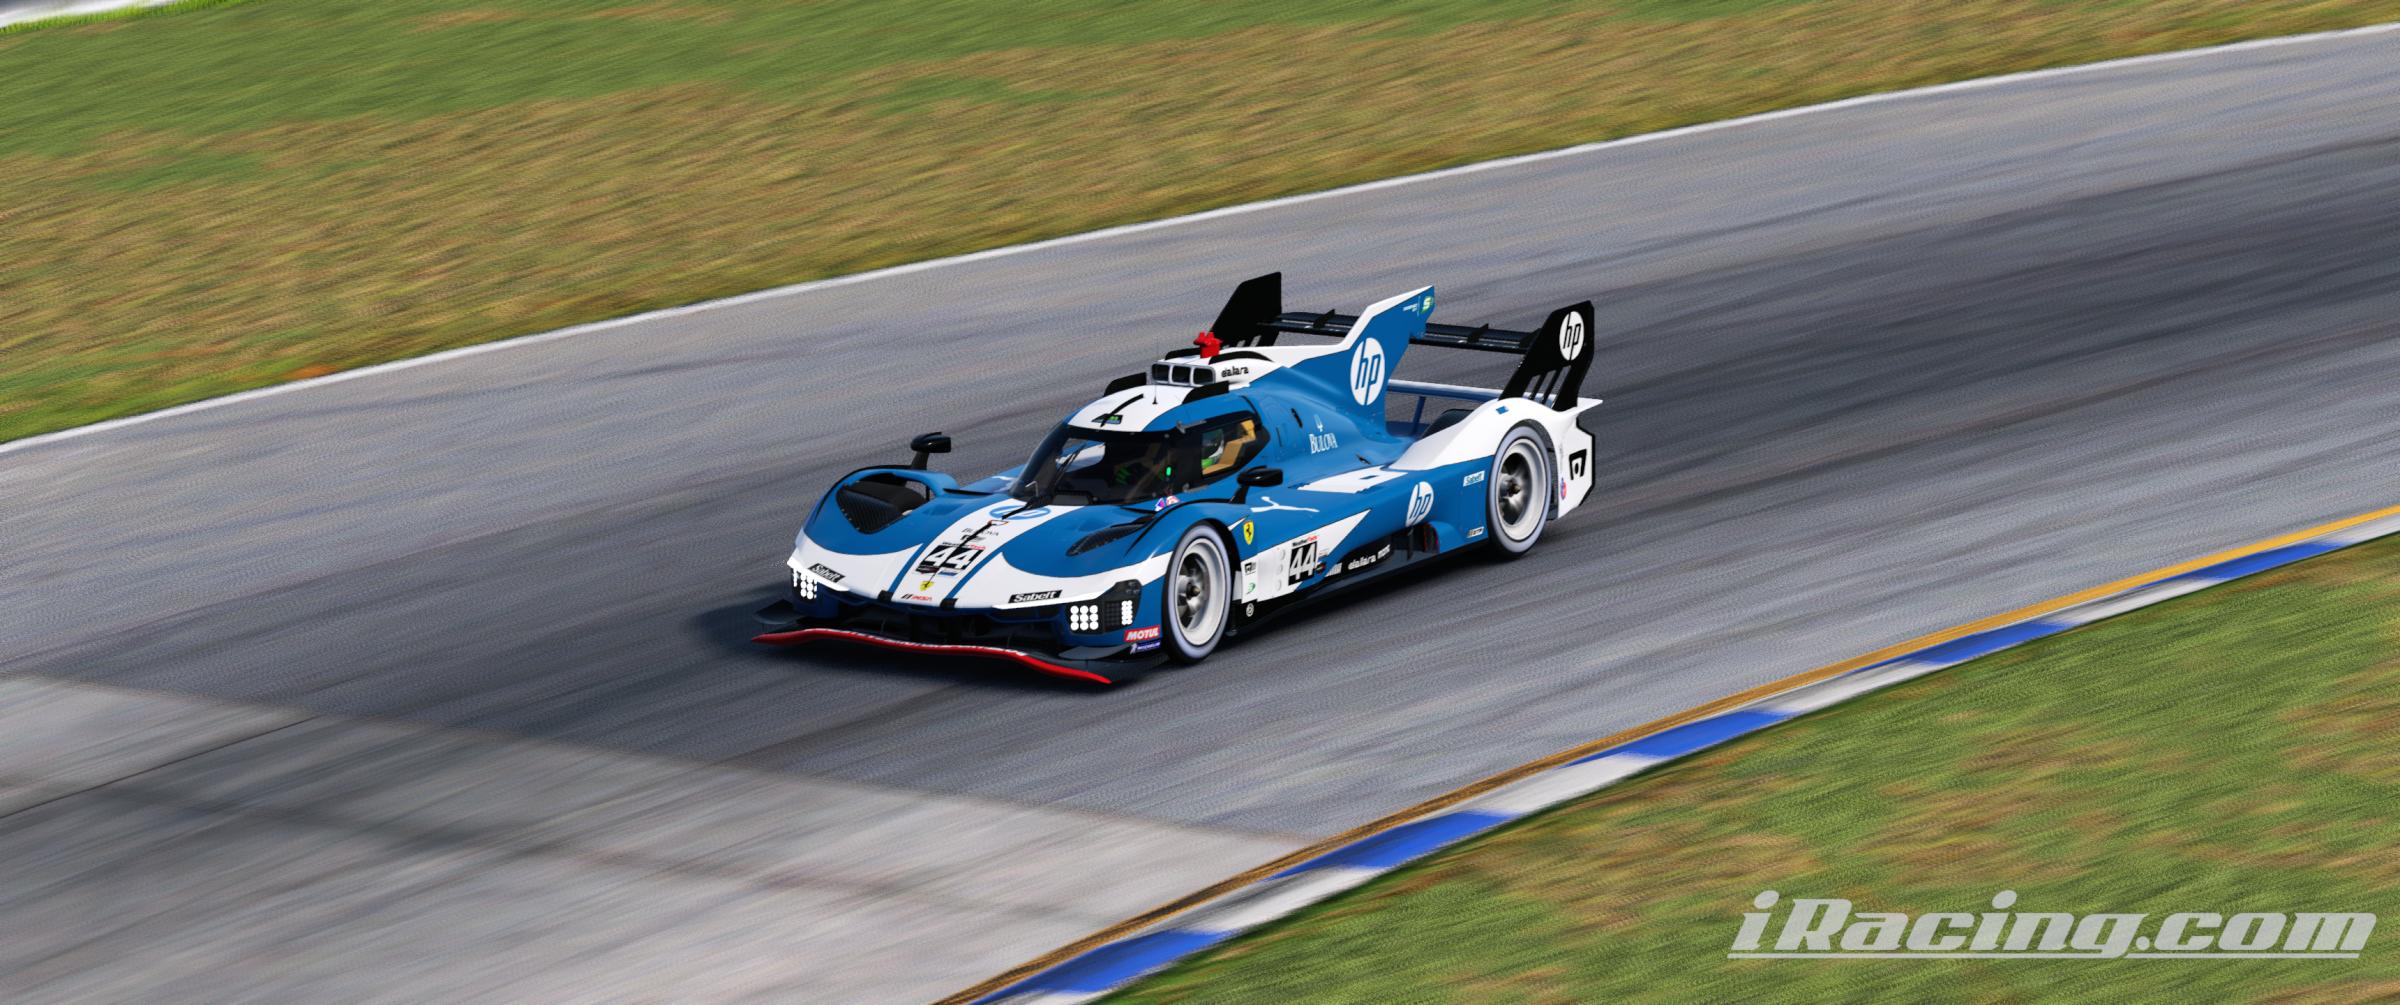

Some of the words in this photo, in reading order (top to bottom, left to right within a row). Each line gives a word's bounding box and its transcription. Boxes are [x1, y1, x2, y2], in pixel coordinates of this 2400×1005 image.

[1561, 312, 1583, 360] hp
[1353, 339, 1383, 405] hp
[1408, 482, 1432, 527] hp
[924, 548, 977, 571] 44
[1289, 543, 1316, 581] 44
[1013, 590, 1056, 602] Sabelt
[1126, 627, 1159, 641] MOTUL
